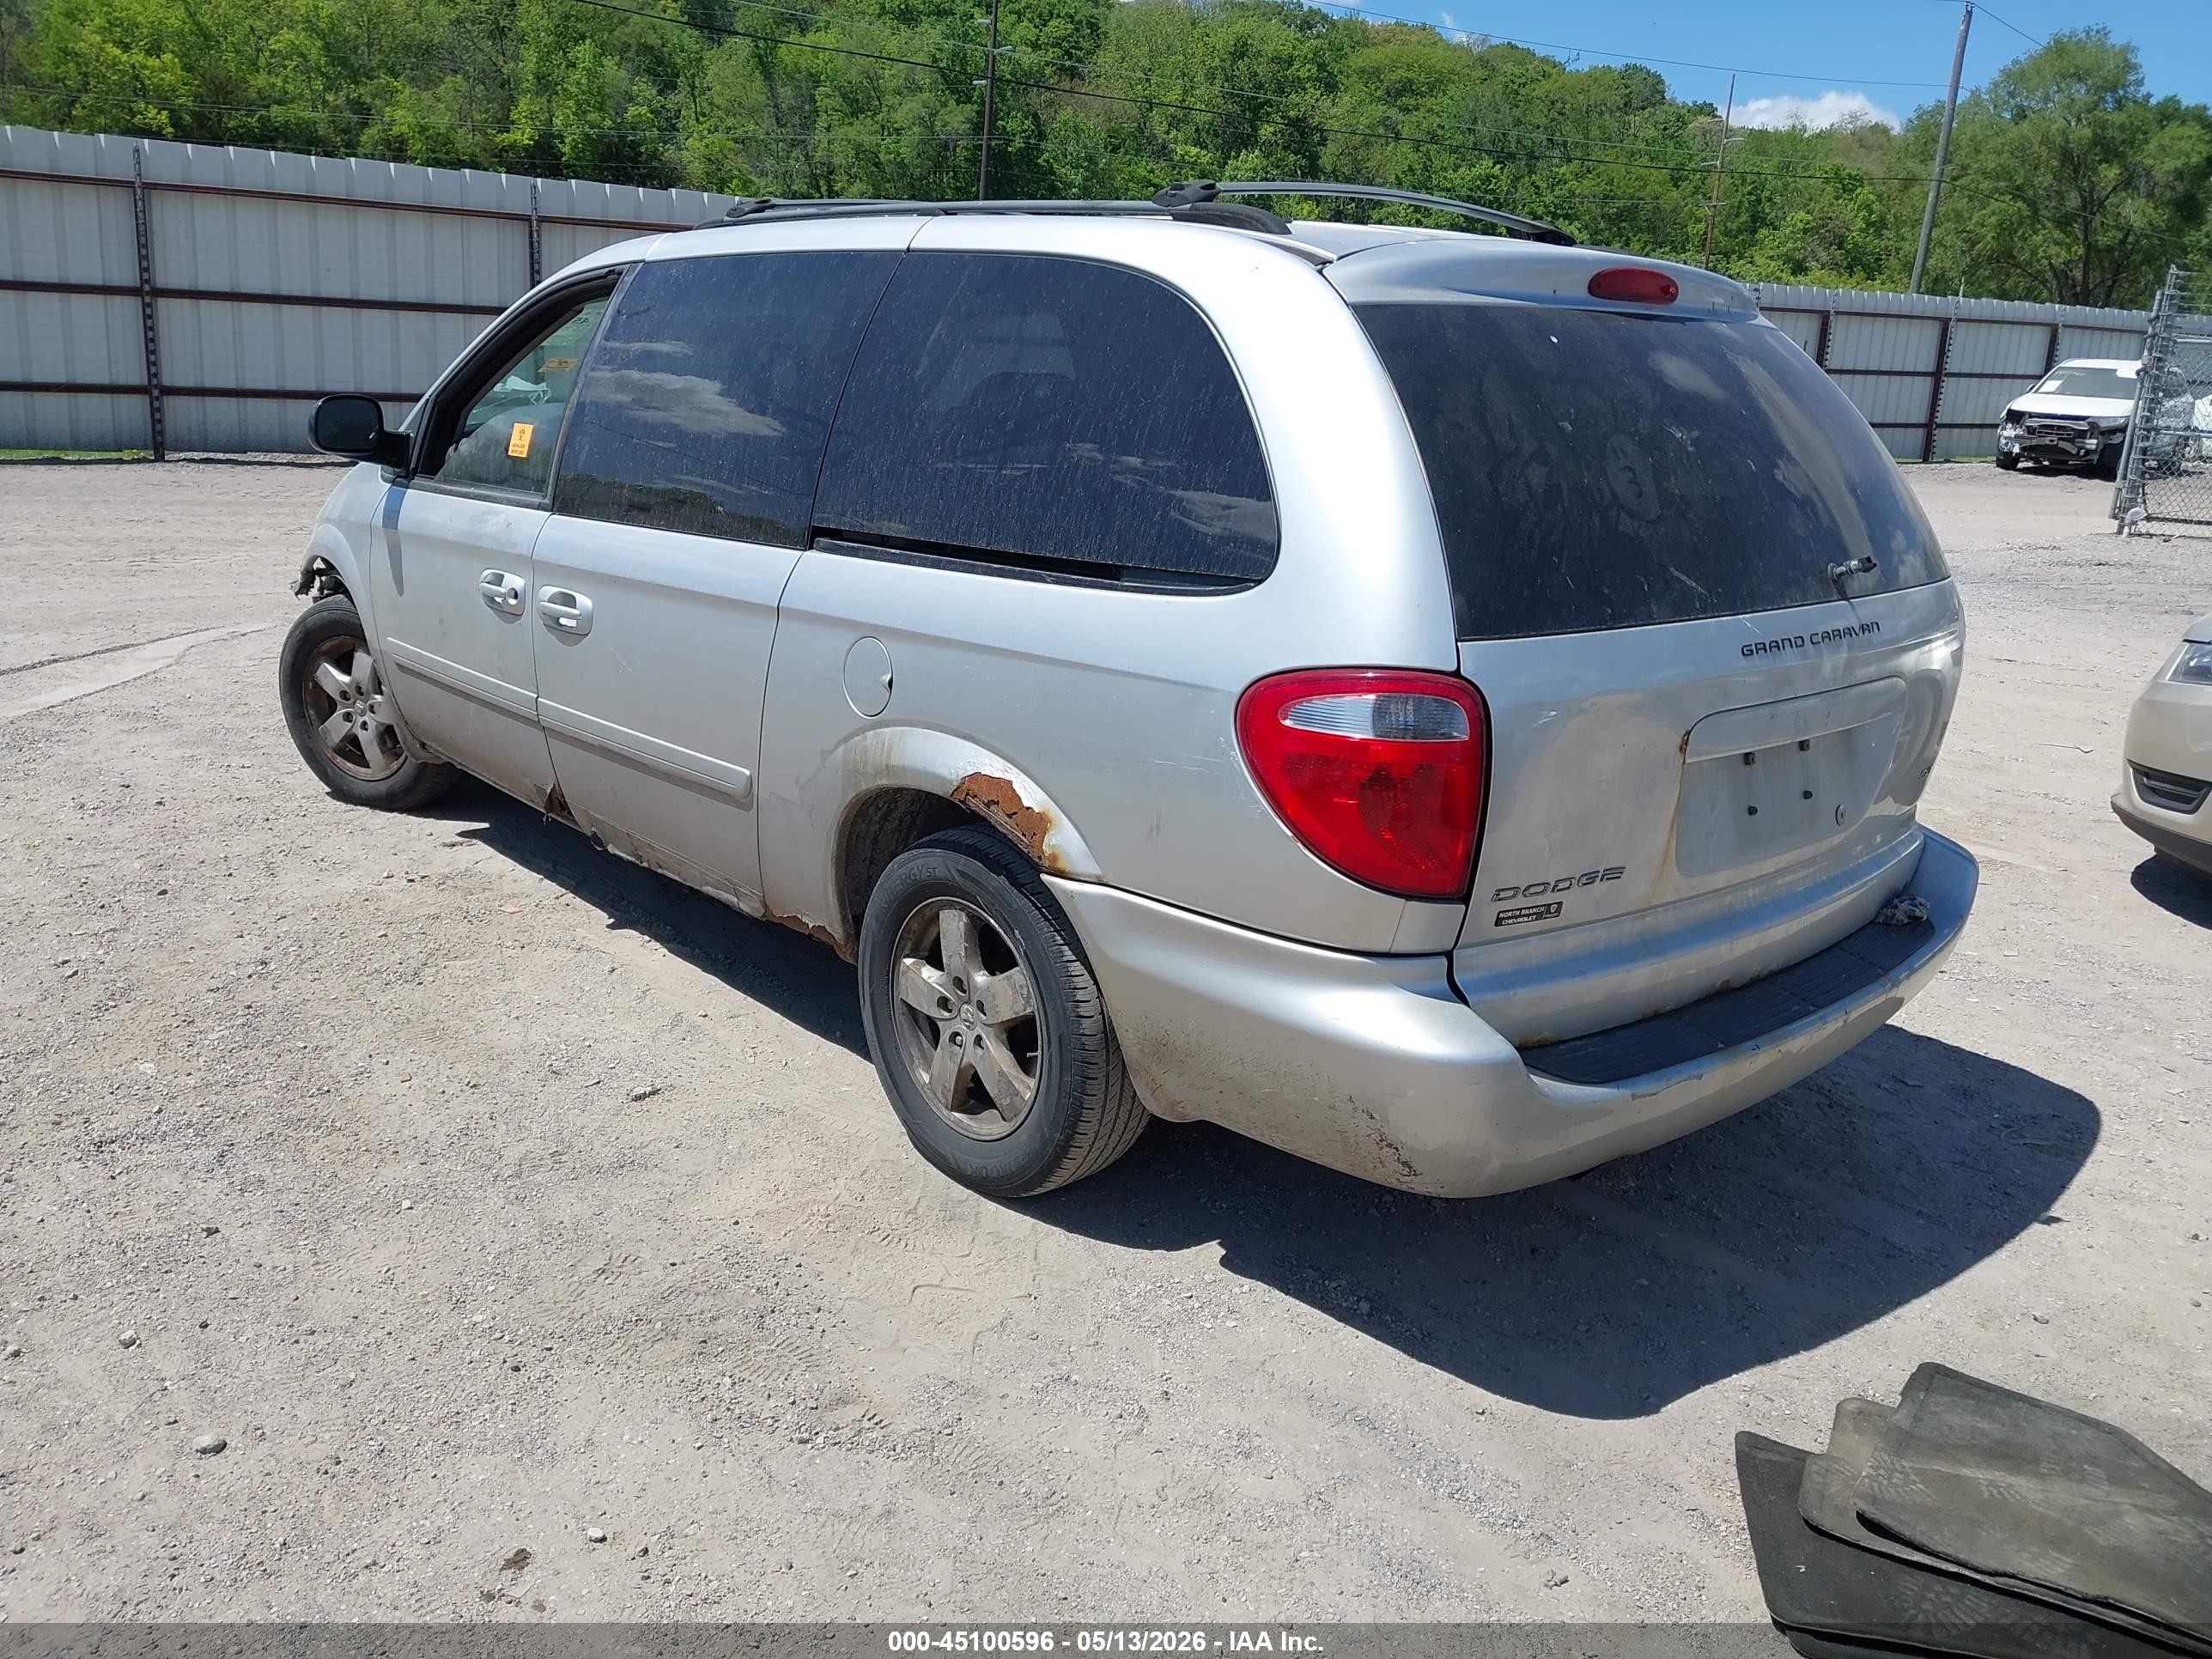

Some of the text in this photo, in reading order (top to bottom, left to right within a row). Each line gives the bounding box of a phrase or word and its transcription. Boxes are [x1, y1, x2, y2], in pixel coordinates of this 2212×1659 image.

[1741, 621, 1881, 657] GRAND CARAVAN
[1490, 866, 1626, 902] DODGE
[1498, 909, 1521, 919] NORTH
[1521, 906, 1545, 915] BRANCH
[1501, 915, 1537, 925] CHEVROLET
